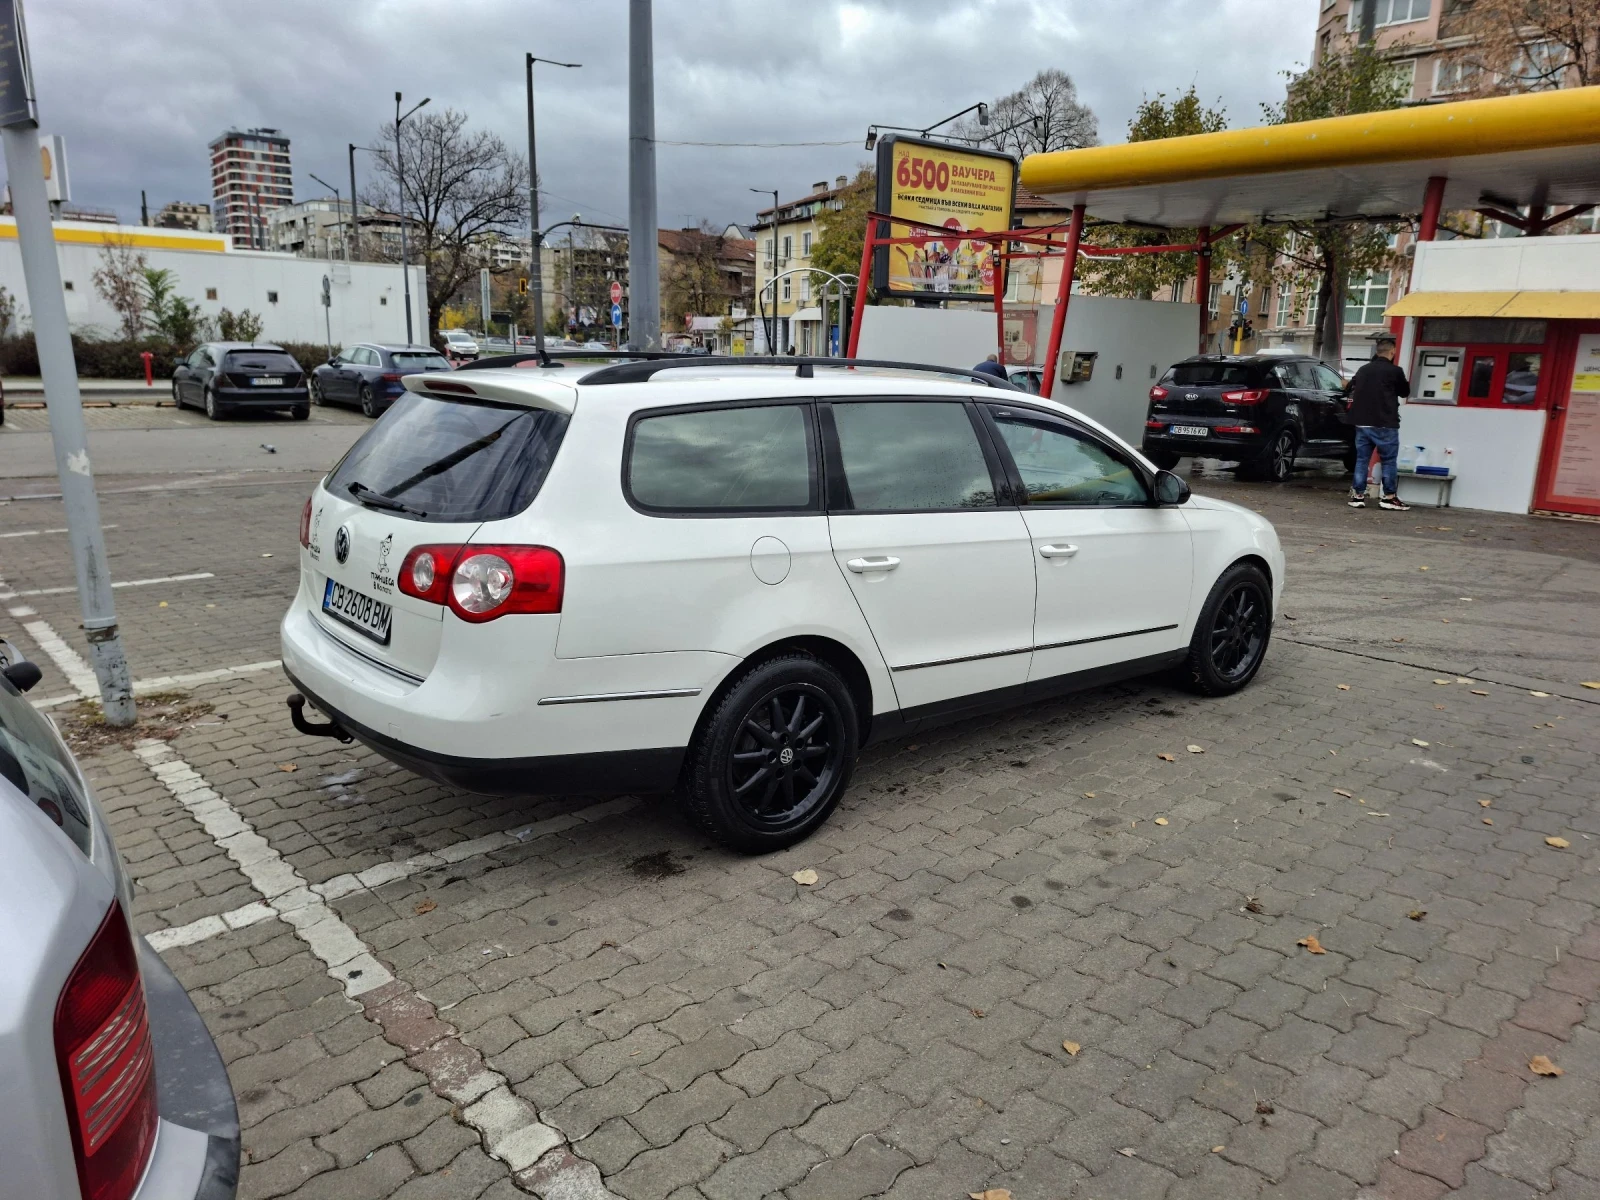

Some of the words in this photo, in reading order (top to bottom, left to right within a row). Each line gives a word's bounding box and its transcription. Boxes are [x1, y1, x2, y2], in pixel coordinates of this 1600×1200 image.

[897, 157, 950, 192] 6500
[951, 164, 996, 183] ВАУЧЕРА
[897, 193, 915, 202] ВСЯКА
[915, 196, 941, 205] СЕДМИЦА
[952, 200, 968, 208] ВСЕКИ
[981, 204, 1003, 212] МАГАЗИН
[331, 581, 345, 610] CB
[344, 588, 373, 624] 2608
[370, 601, 391, 633] BM
